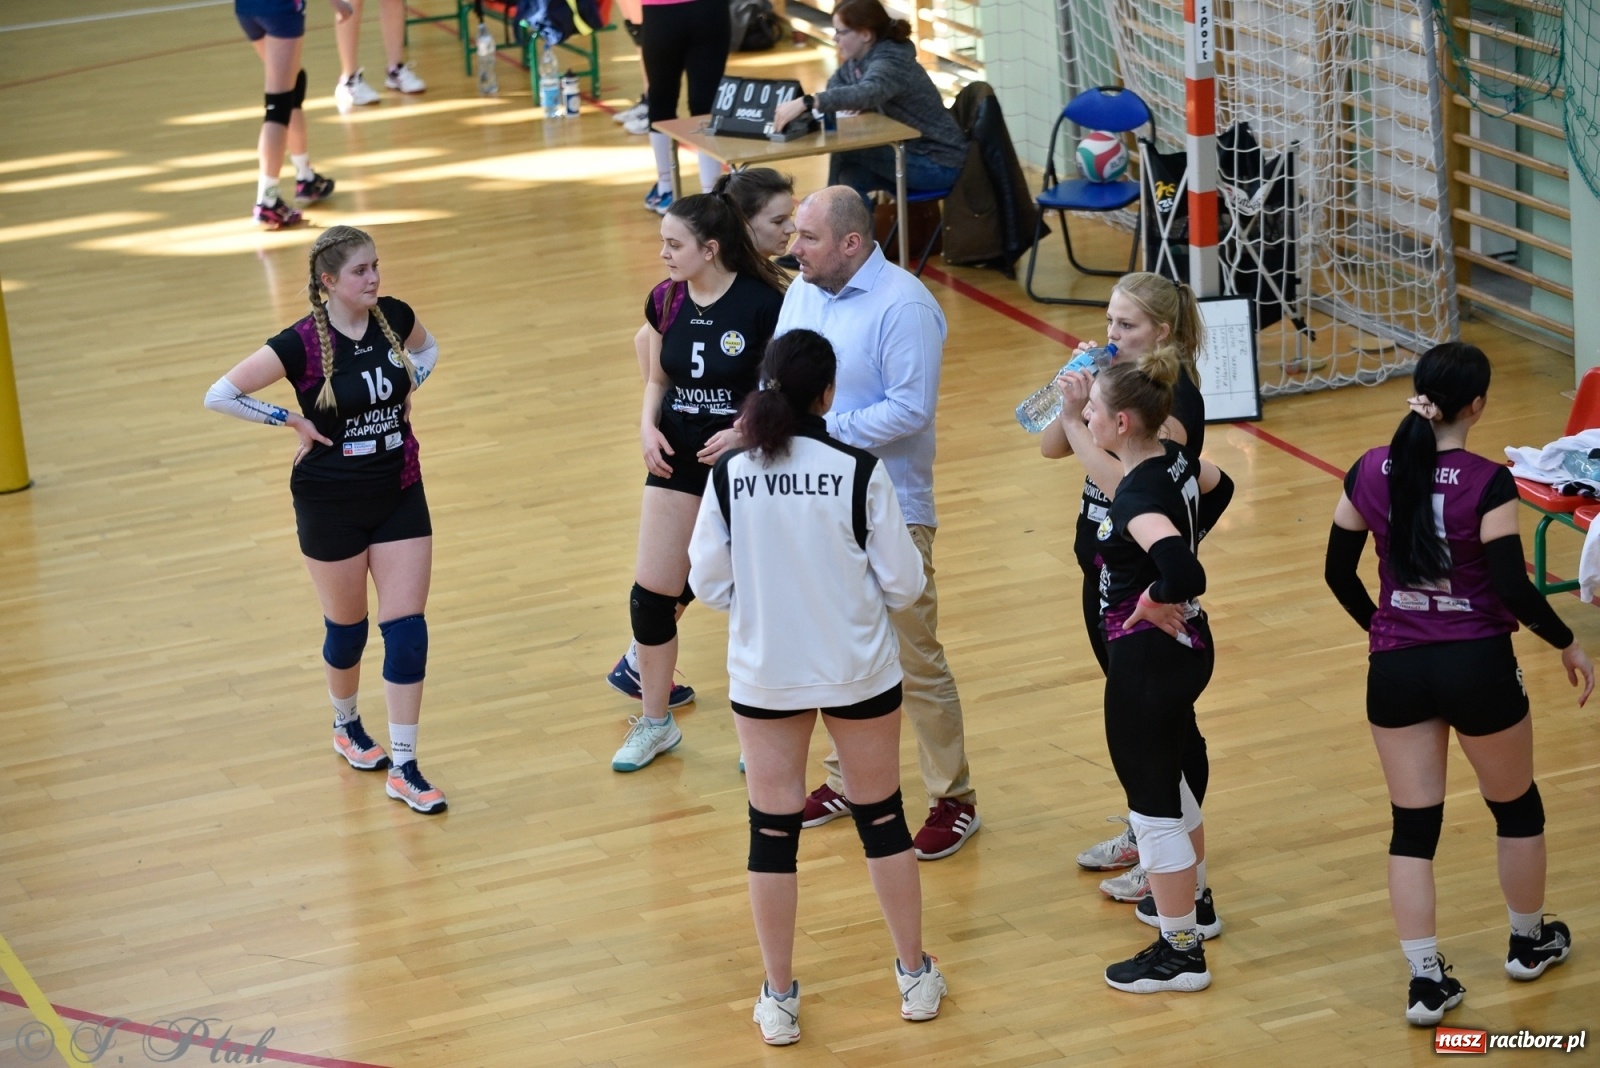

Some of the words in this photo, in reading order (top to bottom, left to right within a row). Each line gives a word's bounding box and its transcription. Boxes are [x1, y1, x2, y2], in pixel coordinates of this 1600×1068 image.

[1200, 6, 1208, 60] sport
[716, 82, 737, 110] 18
[744, 83, 755, 102] 0
[760, 84, 771, 104] 0
[691, 342, 705, 378] 5
[361, 367, 393, 404] 16
[686, 388, 732, 403] VOLLEY
[733, 475, 757, 500] PV
[764, 473, 843, 496] VOLLEY
